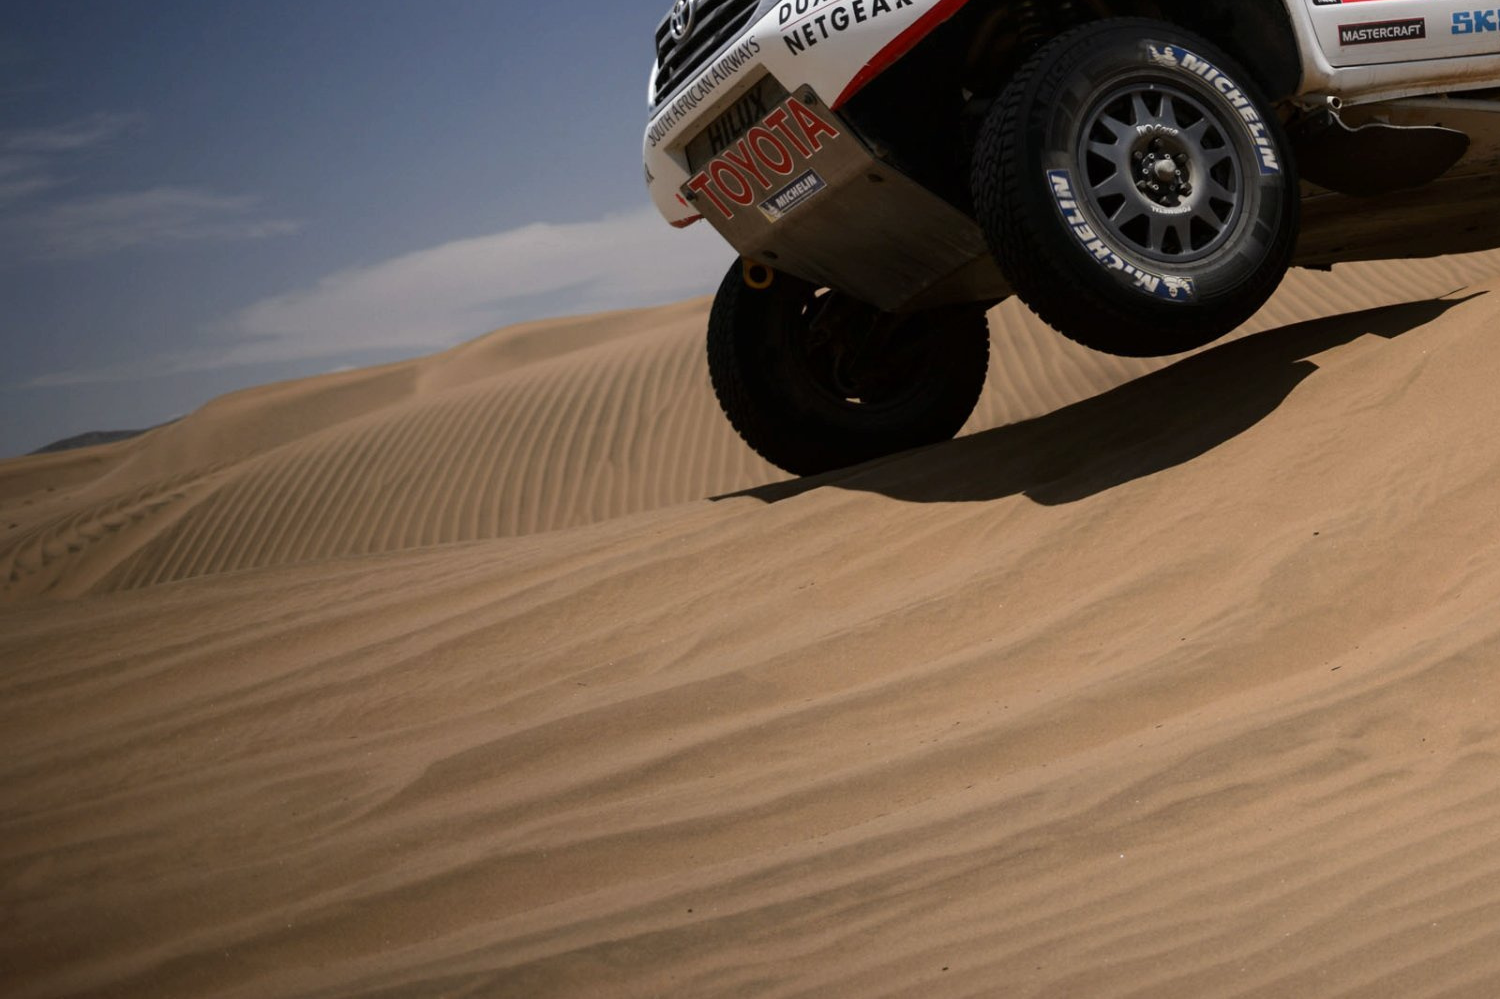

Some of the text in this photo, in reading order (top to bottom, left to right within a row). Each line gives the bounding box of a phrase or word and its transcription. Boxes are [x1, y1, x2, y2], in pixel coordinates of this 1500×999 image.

[1342, 24, 1421, 42] MASTERCRAFT
[648, 35, 761, 147] SOUTH AFRICAN AIRWAYS
[707, 84, 769, 154] HILUX
[1179, 52, 1279, 172] MICHELIN
[687, 96, 840, 220] TOYOTA
[775, 173, 818, 211] MICHELIN
[1050, 174, 1160, 294] MICHELIN
